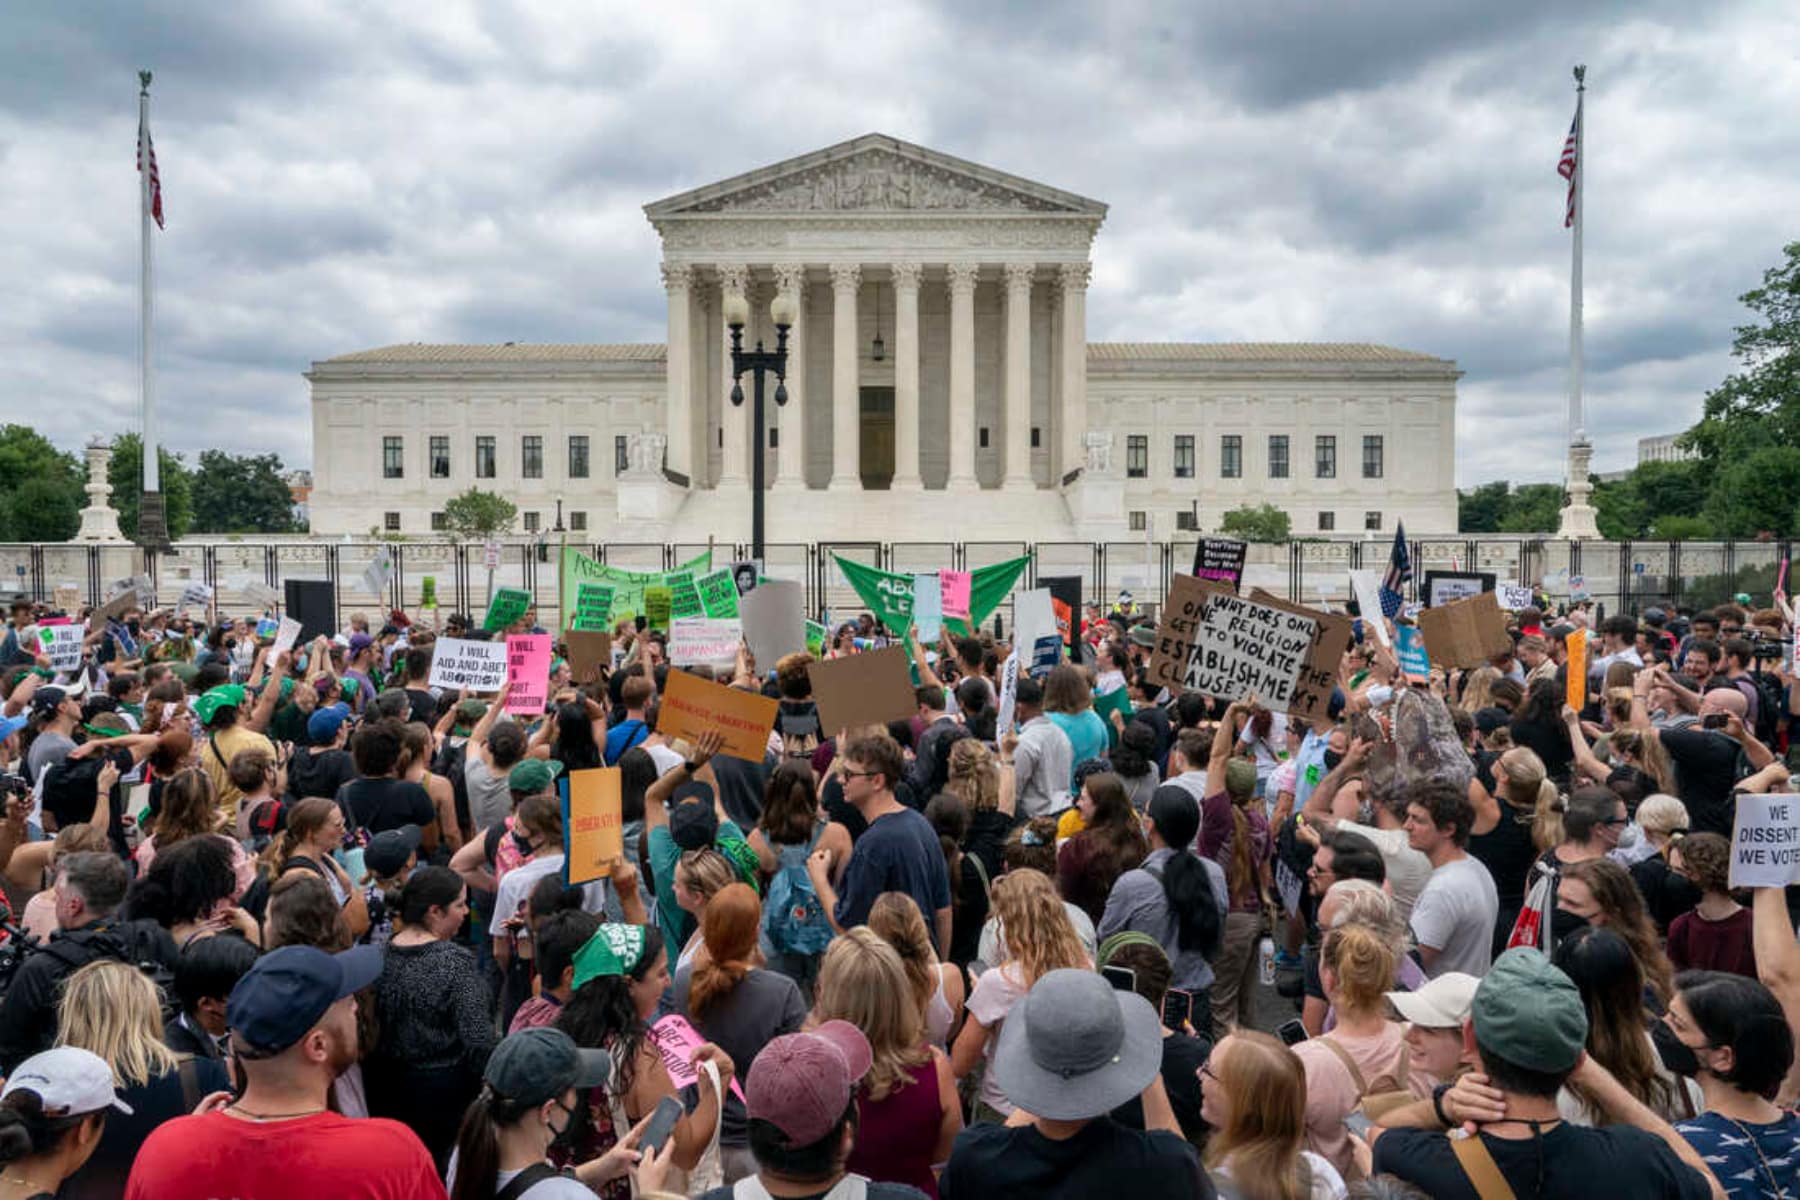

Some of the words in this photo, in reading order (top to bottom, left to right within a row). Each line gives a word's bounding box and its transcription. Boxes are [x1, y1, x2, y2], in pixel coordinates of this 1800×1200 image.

[1184, 601, 1216, 624] ONE
[1228, 617, 1307, 653] RELIGION
[1214, 595, 1246, 614] WHY
[1249, 605, 1283, 629] DOES
[1287, 618, 1328, 646] ONLY
[468, 646, 490, 659] WILL
[515, 641, 536, 652] WILL
[1171, 618, 1198, 634] GET
[1204, 626, 1227, 641] TO
[1234, 636, 1297, 674] VIOLATE
[1299, 664, 1332, 687] THE
[437, 658, 455, 670] AID
[457, 659, 479, 672] AND
[481, 661, 507, 673] ABET
[440, 671, 502, 686] ABORTION
[1768, 804, 1789, 821] WE
[1739, 826, 1799, 844] DISSENT
[1739, 849, 1766, 865] WE
